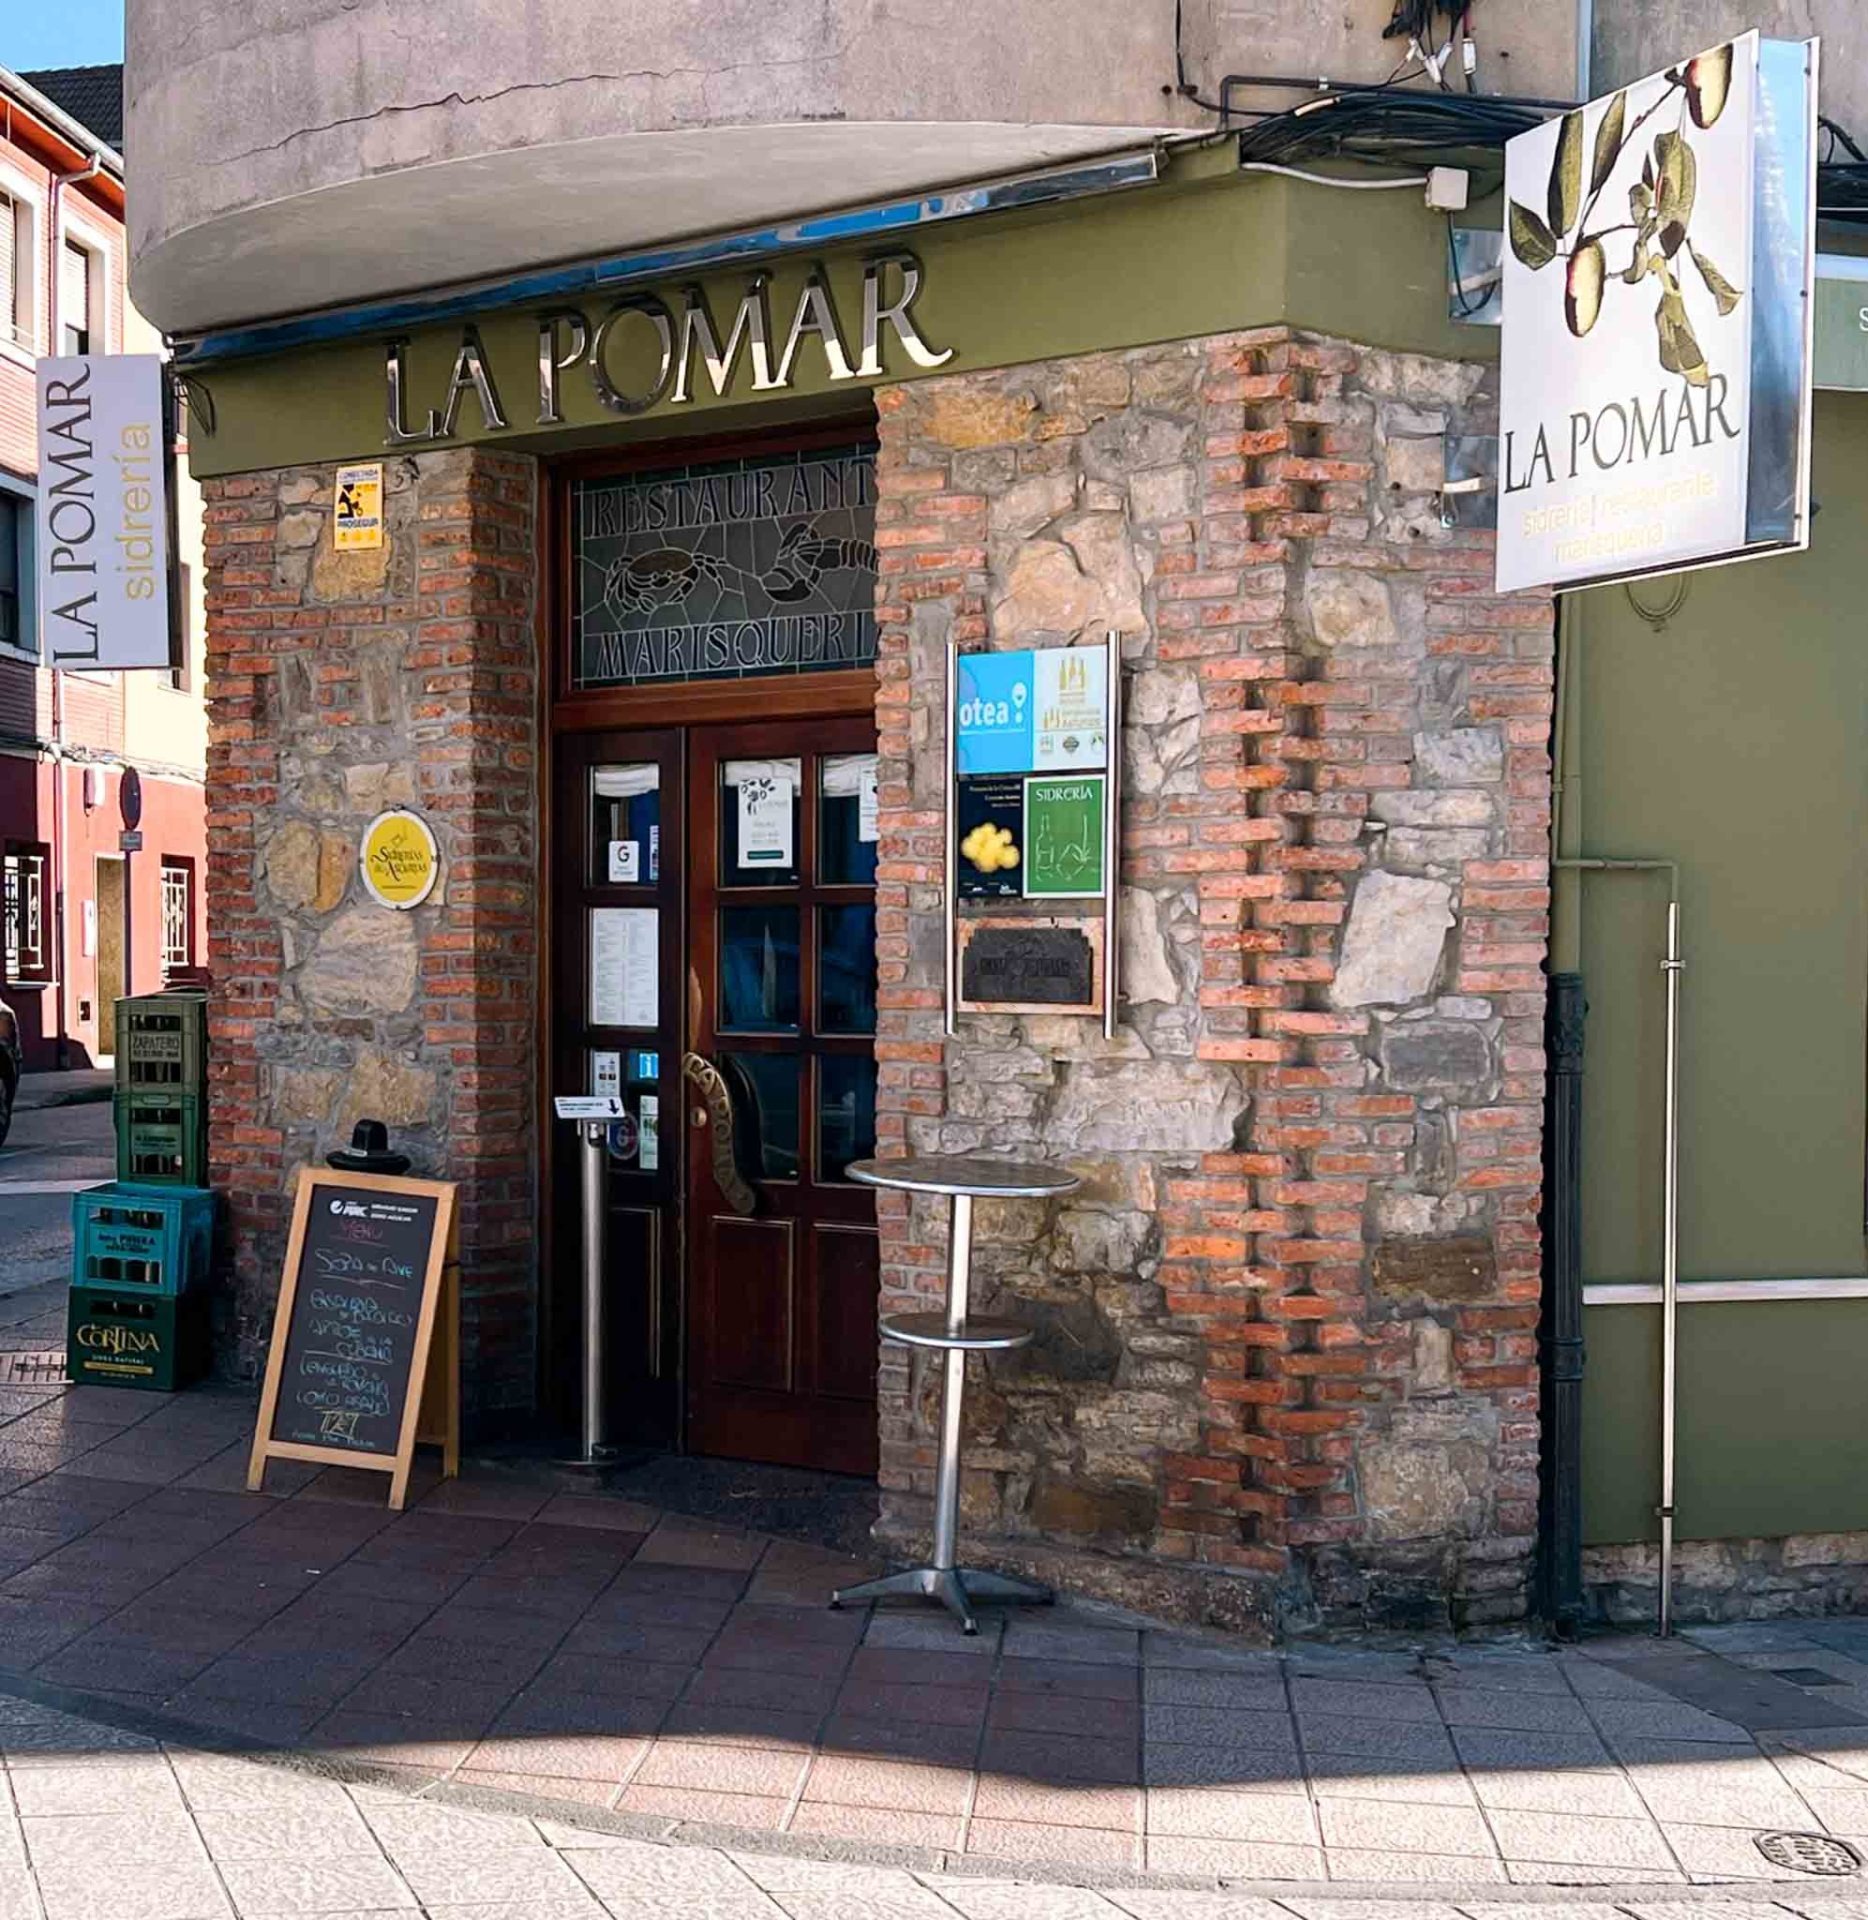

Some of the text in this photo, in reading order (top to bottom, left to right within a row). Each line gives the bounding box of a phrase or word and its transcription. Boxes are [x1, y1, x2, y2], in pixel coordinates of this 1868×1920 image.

[383, 248, 956, 447] LA POMAR
[1504, 373, 1740, 494] LA POMAR
[45, 362, 99, 664] LA POMAR
[114, 423, 154, 600] sidrería
[598, 612, 880, 678] MARISQUERI
[133, 1035, 179, 1049] ZAPATERO
[77, 1324, 160, 1354] CORTINA
